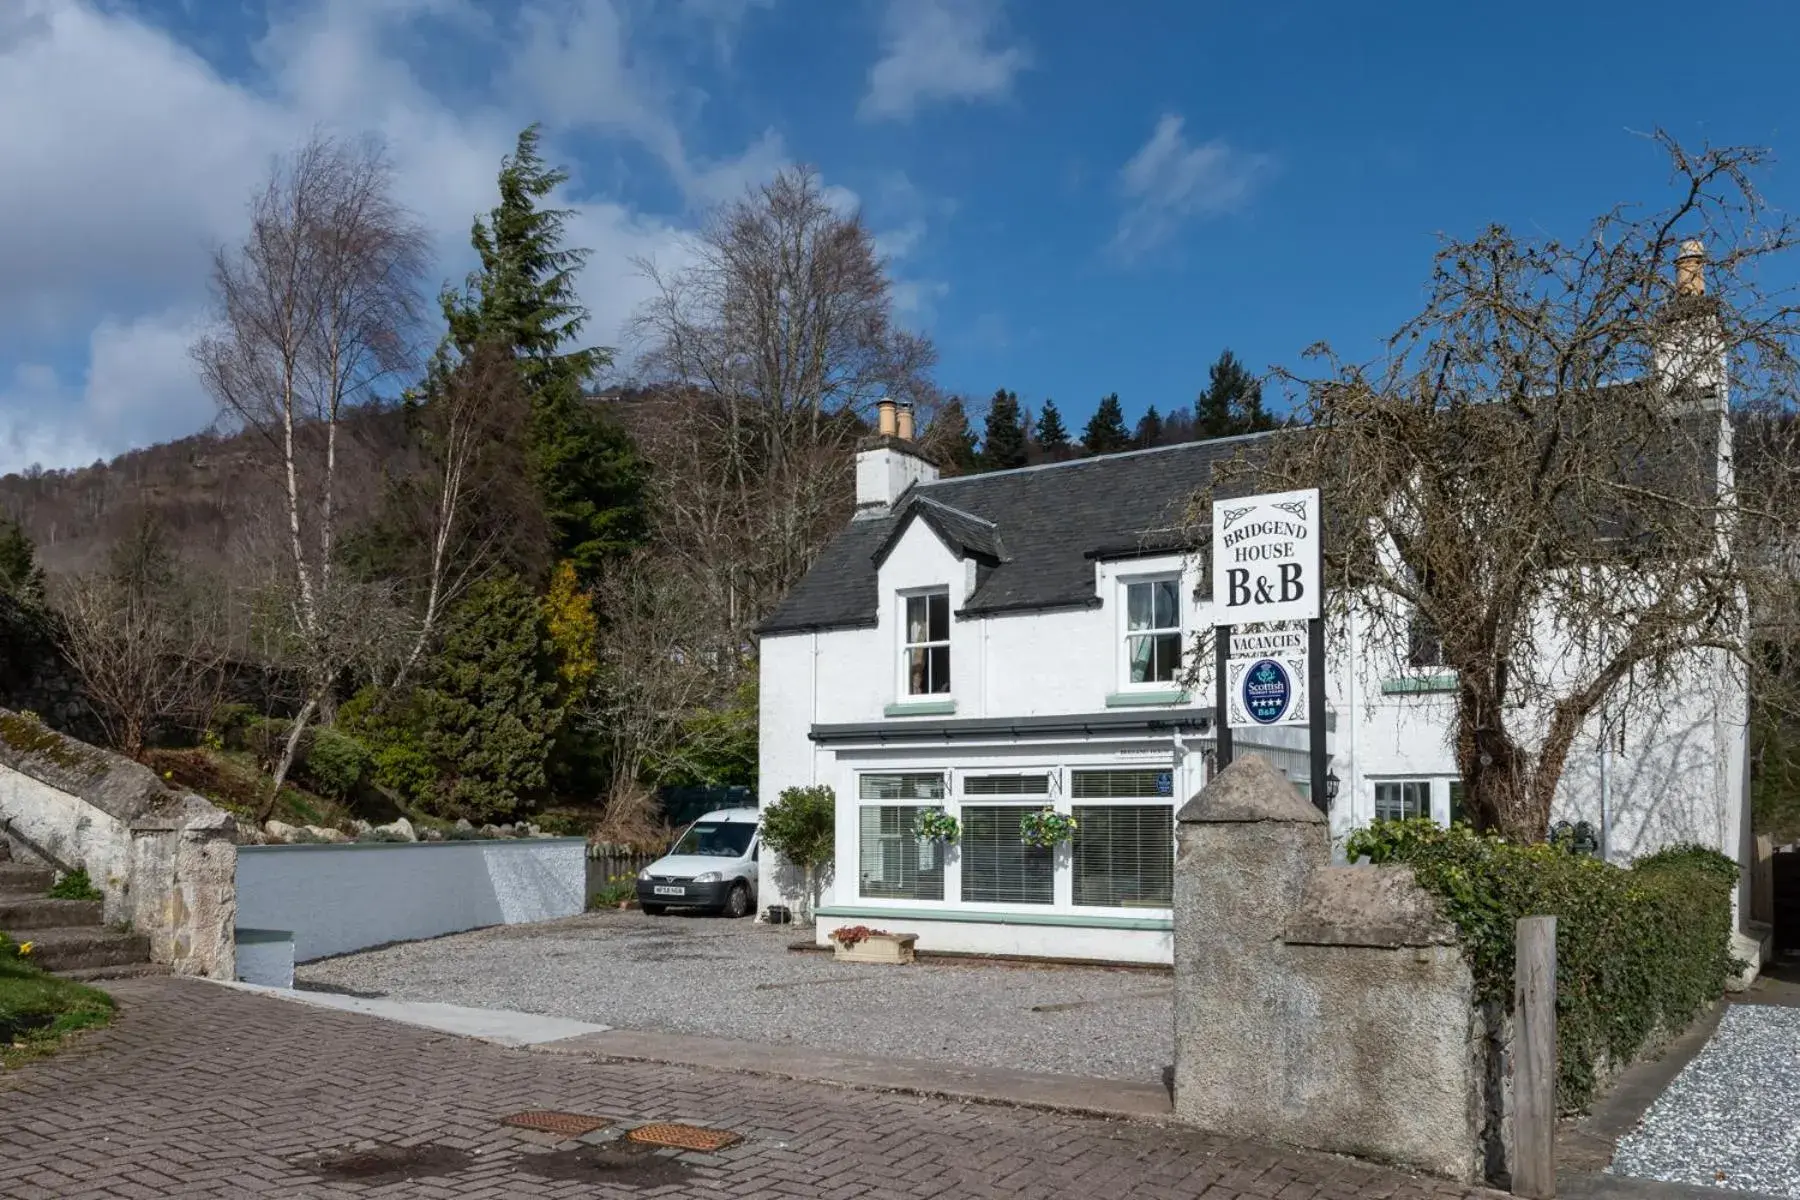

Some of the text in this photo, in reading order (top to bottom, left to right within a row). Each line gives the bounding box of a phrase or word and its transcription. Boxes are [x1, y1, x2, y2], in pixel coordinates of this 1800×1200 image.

[1223, 520, 1307, 548] BRIDGEND
[1235, 542, 1294, 562] HOUSE
[1225, 562, 1304, 607] B&B
[1234, 634, 1300, 650] VACANCIES
[1248, 681, 1284, 692] Scottish
